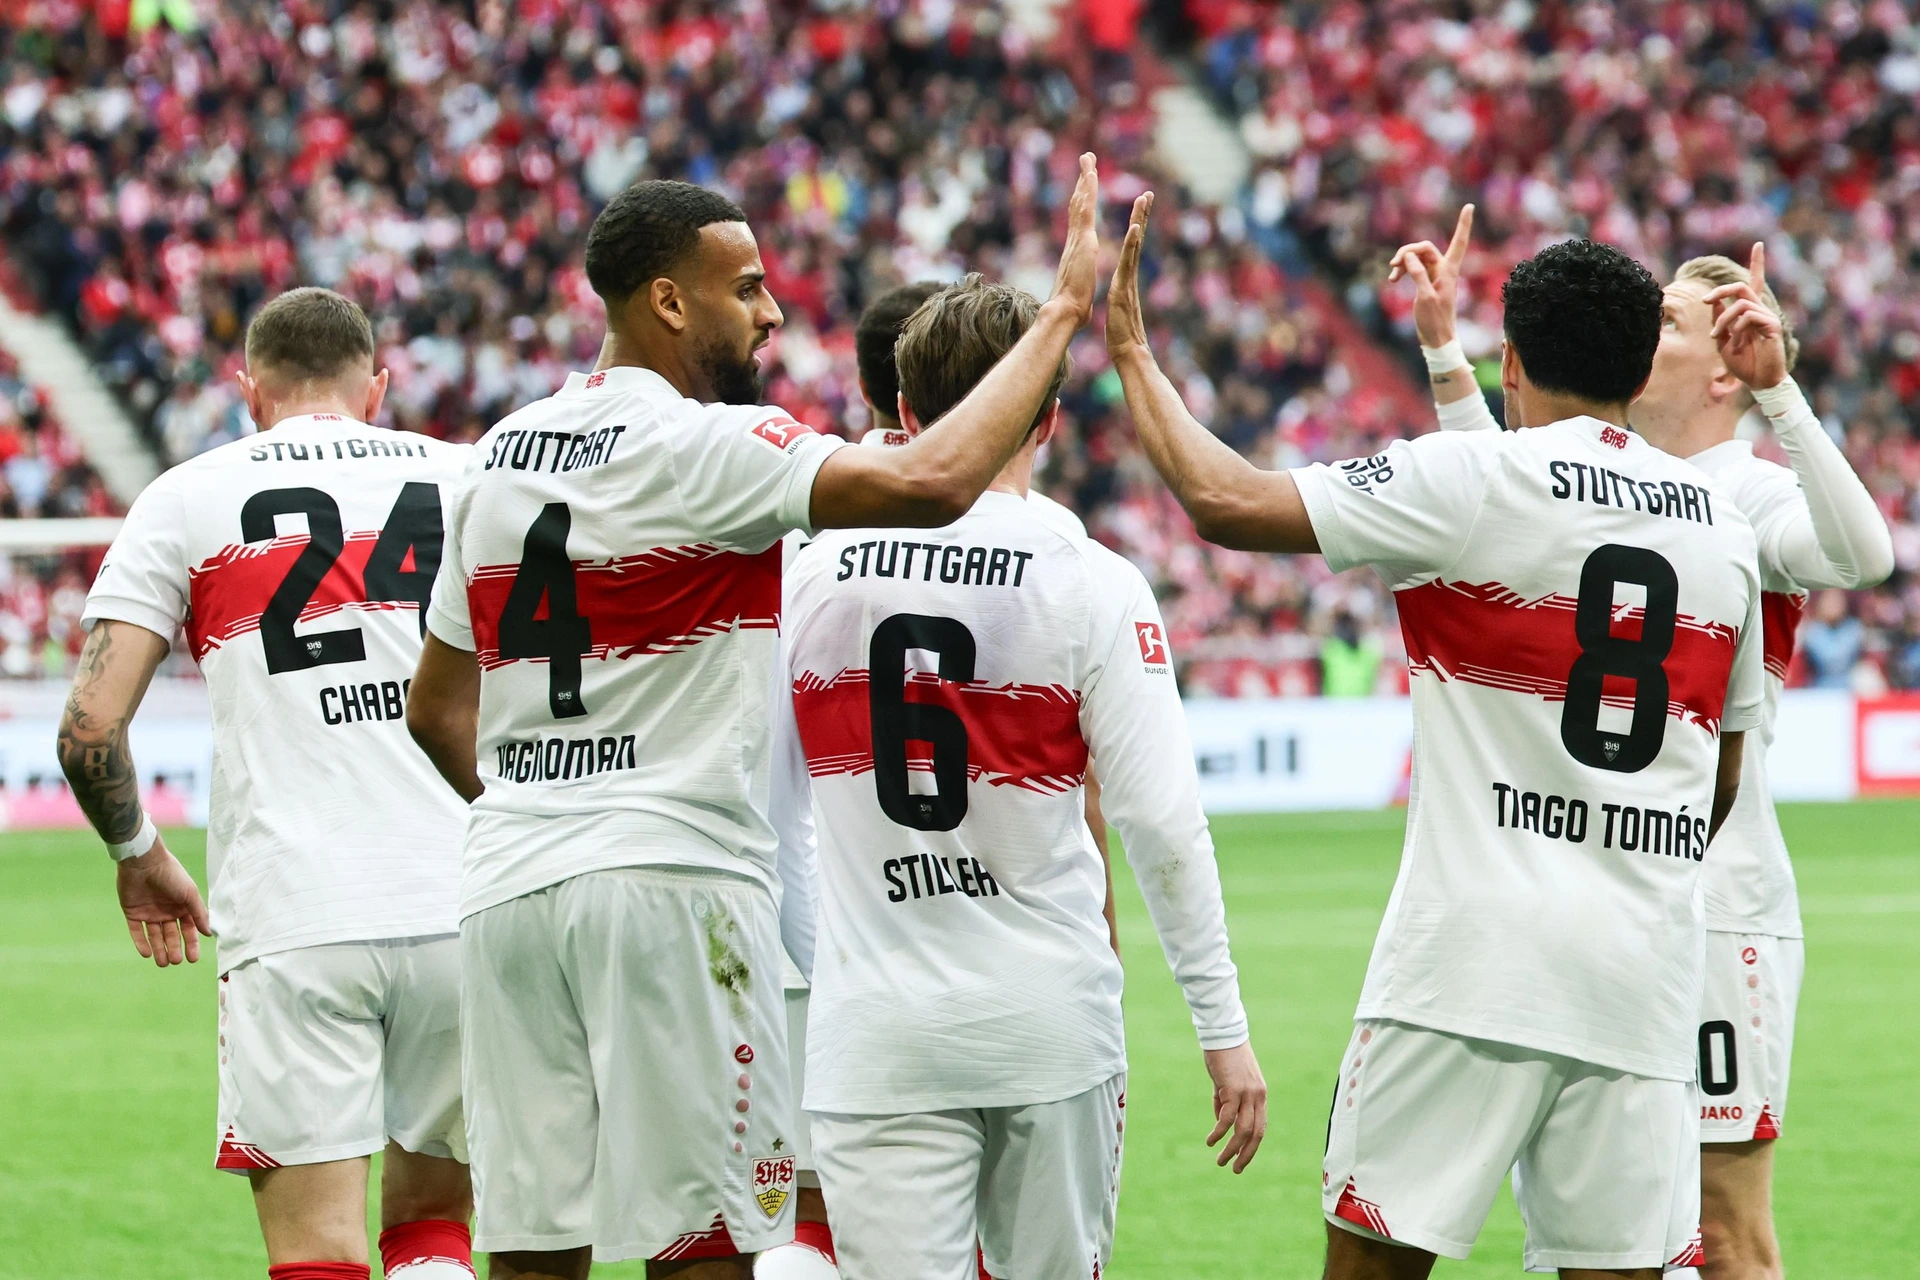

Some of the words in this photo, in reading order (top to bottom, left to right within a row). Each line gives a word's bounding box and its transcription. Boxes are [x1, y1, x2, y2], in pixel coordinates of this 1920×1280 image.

[250, 438, 427, 462] STUTTGART
[485, 425, 627, 474] STUTTGART
[1549, 460, 1713, 526] STUTTGART
[240, 481, 444, 676] 24
[837, 540, 1034, 588] STUTTGART
[497, 502, 593, 720] 4
[1560, 543, 1679, 774] 8
[869, 613, 976, 832] 6
[496, 734, 636, 784] VAGNOMAN
[1493, 782, 1589, 843] TIAGO
[1602, 804, 1706, 862] TOMÁS
[883, 853, 1000, 903] STILLER
[1700, 1105, 1743, 1120] JAKO
